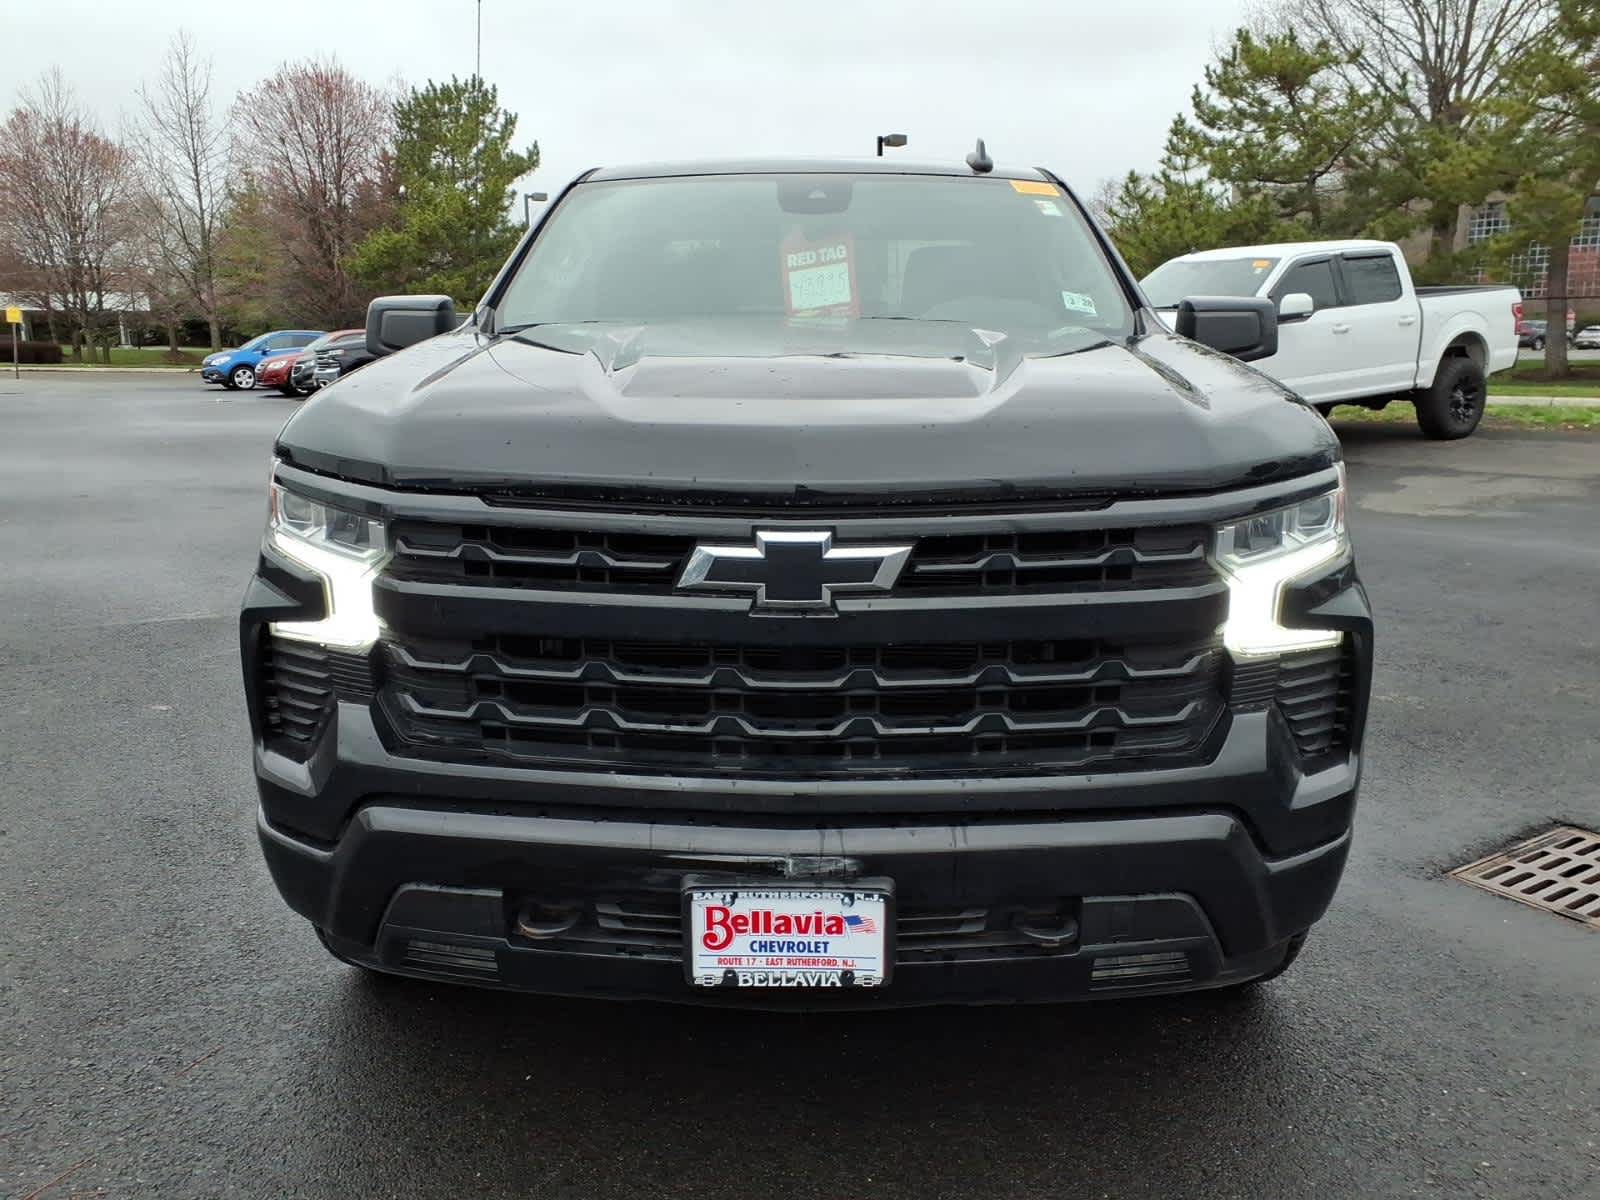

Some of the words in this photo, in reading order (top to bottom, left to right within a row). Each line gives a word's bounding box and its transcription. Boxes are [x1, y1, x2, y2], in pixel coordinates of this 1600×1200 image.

[787, 251, 817, 268] RED
[817, 245, 847, 262] TAG
[702, 905, 846, 951] Bellavia
[749, 940, 830, 954] CHEVROLET
[717, 957, 742, 966] ROUTE
[746, 958, 757, 966] 17
[765, 958, 784, 966] EAST
[737, 970, 843, 987] BELLAVIA
